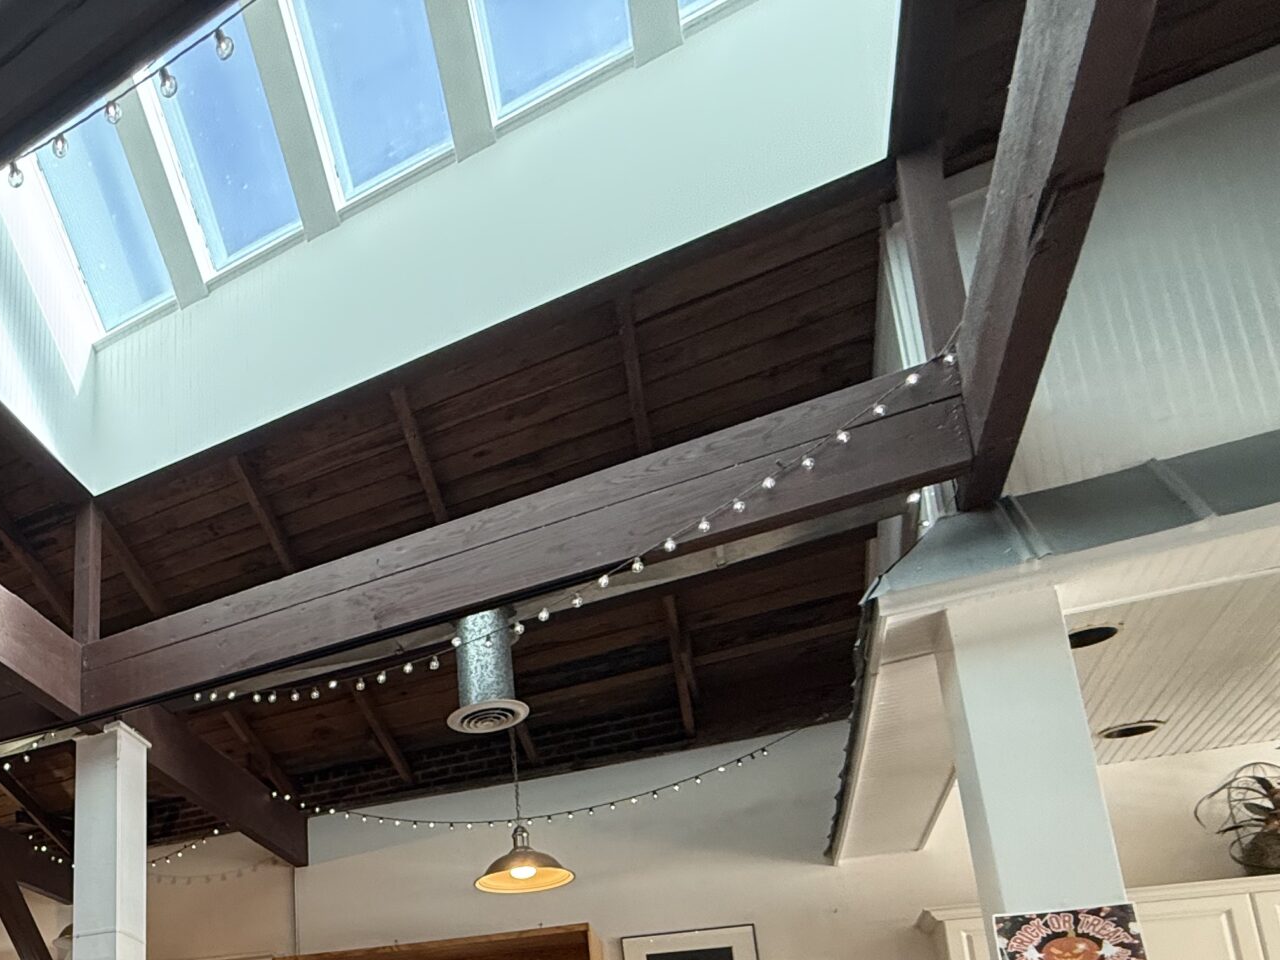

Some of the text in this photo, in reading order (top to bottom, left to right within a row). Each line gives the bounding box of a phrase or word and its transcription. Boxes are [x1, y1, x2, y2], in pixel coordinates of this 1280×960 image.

[1008, 913, 1134, 952] TRICK OR TREAT
